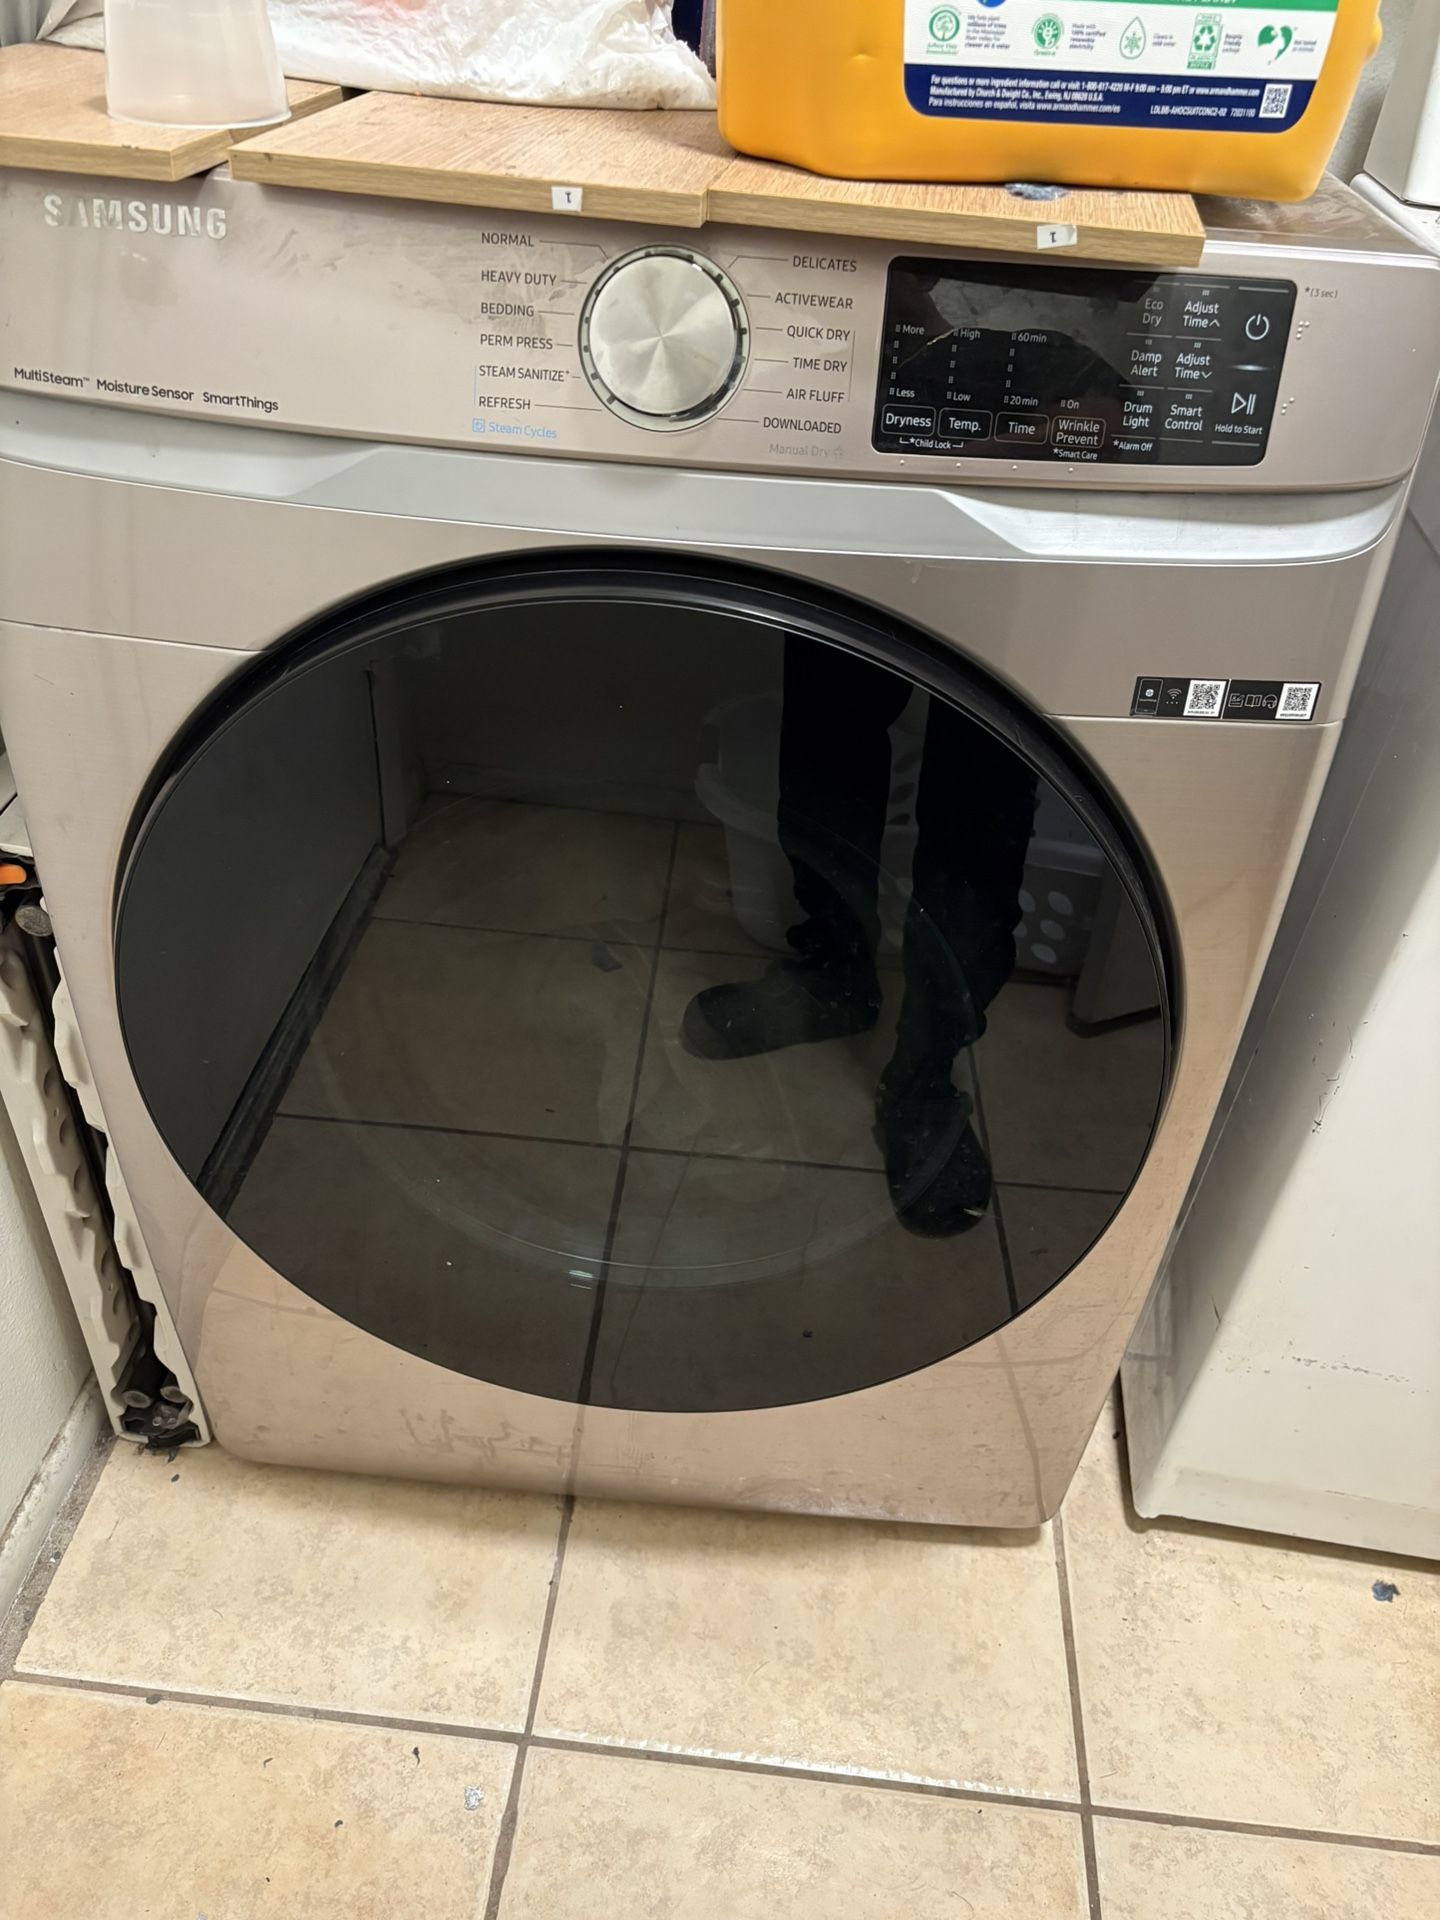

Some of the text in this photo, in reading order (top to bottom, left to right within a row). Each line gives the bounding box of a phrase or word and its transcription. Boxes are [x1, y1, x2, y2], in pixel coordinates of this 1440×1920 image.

[43, 194, 228, 240] SAMSUNG
[481, 232, 535, 248] NORMAL
[792, 255, 858, 273] DELICATES
[481, 269, 557, 287] HEAVY DUTY
[775, 291, 854, 310] ACTIVEWEAR
[1144, 298, 1164, 311] Eco
[480, 302, 534, 318] BEDDING
[1184, 301, 1220, 316] Adjust
[1142, 312, 1162, 328] Dry
[1183, 315, 1209, 328] Time
[787, 325, 850, 342] QUICK DRY
[902, 324, 925, 335] More
[960, 328, 981, 341] High
[480, 333, 554, 350] PERM PRESS
[1131, 350, 1162, 364] Damp
[1176, 352, 1211, 367] Adjust
[479, 365, 516, 379] STEAM
[793, 357, 848, 373] TIME DRY
[1130, 364, 1158, 377] Alert
[1175, 367, 1200, 379] Time
[96, 378, 150, 397] Moisture
[151, 385, 195, 401] Sensor
[203, 391, 279, 414] SmartThings
[786, 388, 845, 403] AIR FLUFF
[896, 387, 916, 398] Less
[953, 391, 971, 402] Low
[479, 396, 531, 410] REFRESH
[1067, 399, 1080, 409] On
[1123, 401, 1153, 414] Drum
[1170, 403, 1203, 418] Smart
[763, 416, 842, 434] DOWNLOADED
[885, 413, 932, 429] Dryness
[949, 417, 982, 433] Temp.
[1008, 421, 1036, 435] Time
[1058, 418, 1100, 433] Wrinkle
[1122, 415, 1151, 430] Light
[1164, 418, 1203, 431] Control
[488, 421, 558, 440] Steam Cycles
[1215, 423, 1263, 436] Hold to Start
[935, 440, 951, 450] Lock
[1055, 431, 1099, 446] Prevent
[769, 443, 832, 459] Manual Dry
[1140, 442, 1153, 452] Off
[1081, 450, 1098, 460] Care
